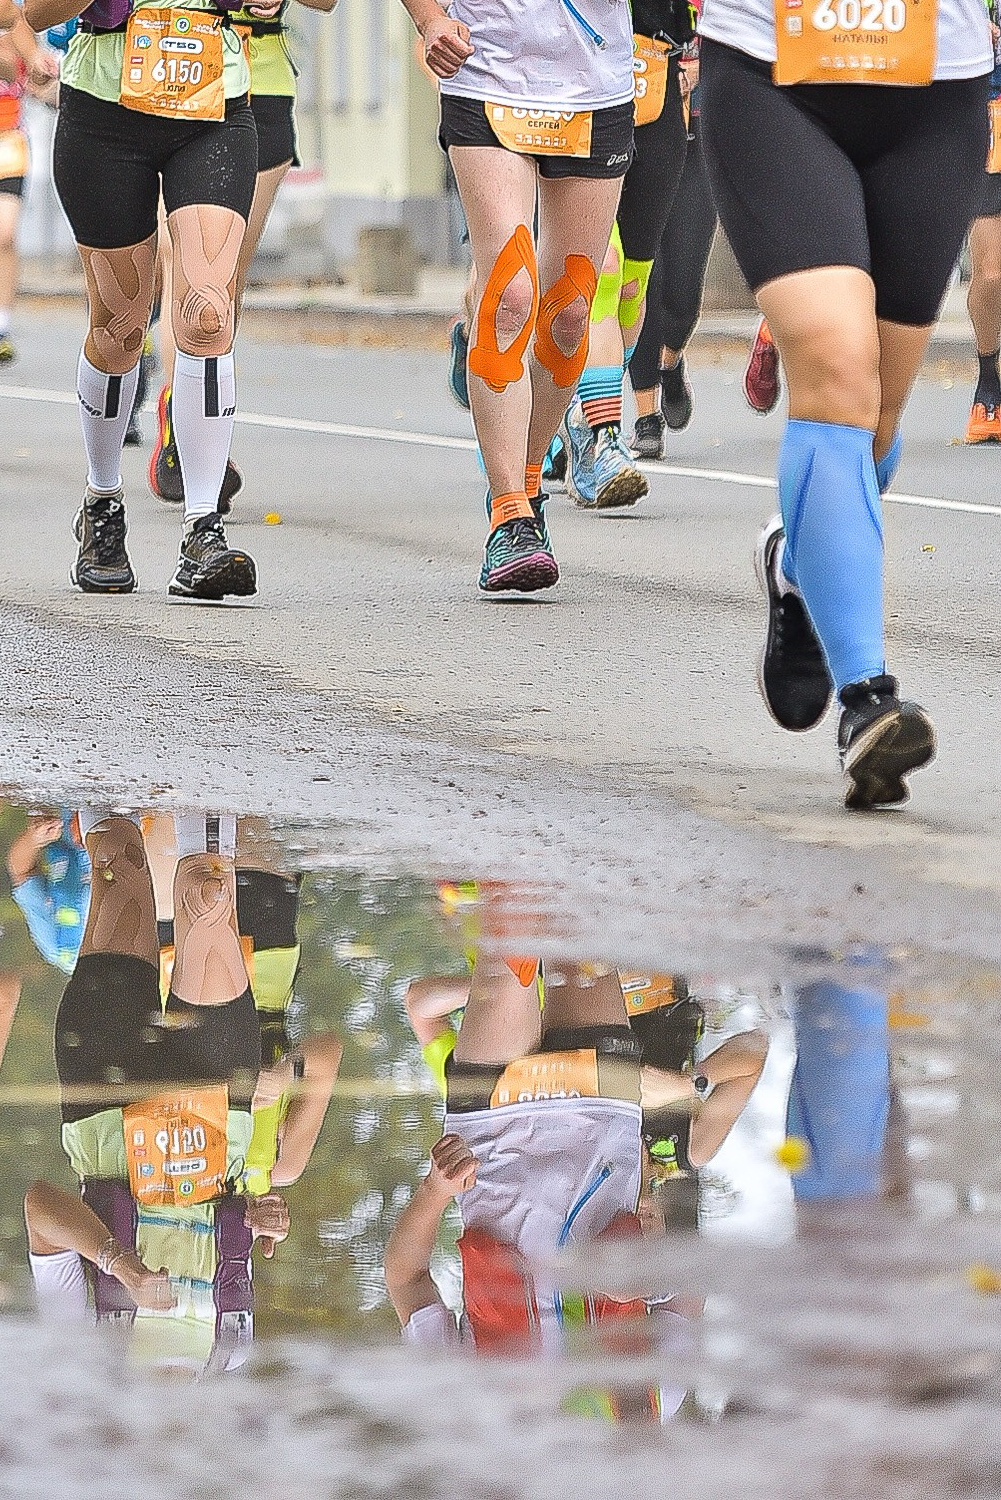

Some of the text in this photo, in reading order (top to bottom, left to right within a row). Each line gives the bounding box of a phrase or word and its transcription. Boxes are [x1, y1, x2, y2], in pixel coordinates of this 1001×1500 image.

[832, 33, 888, 44] НАТАЛЬЯ
[151, 58, 203, 85] 6150
[527, 120, 560, 130] СЕРГЕЙ
